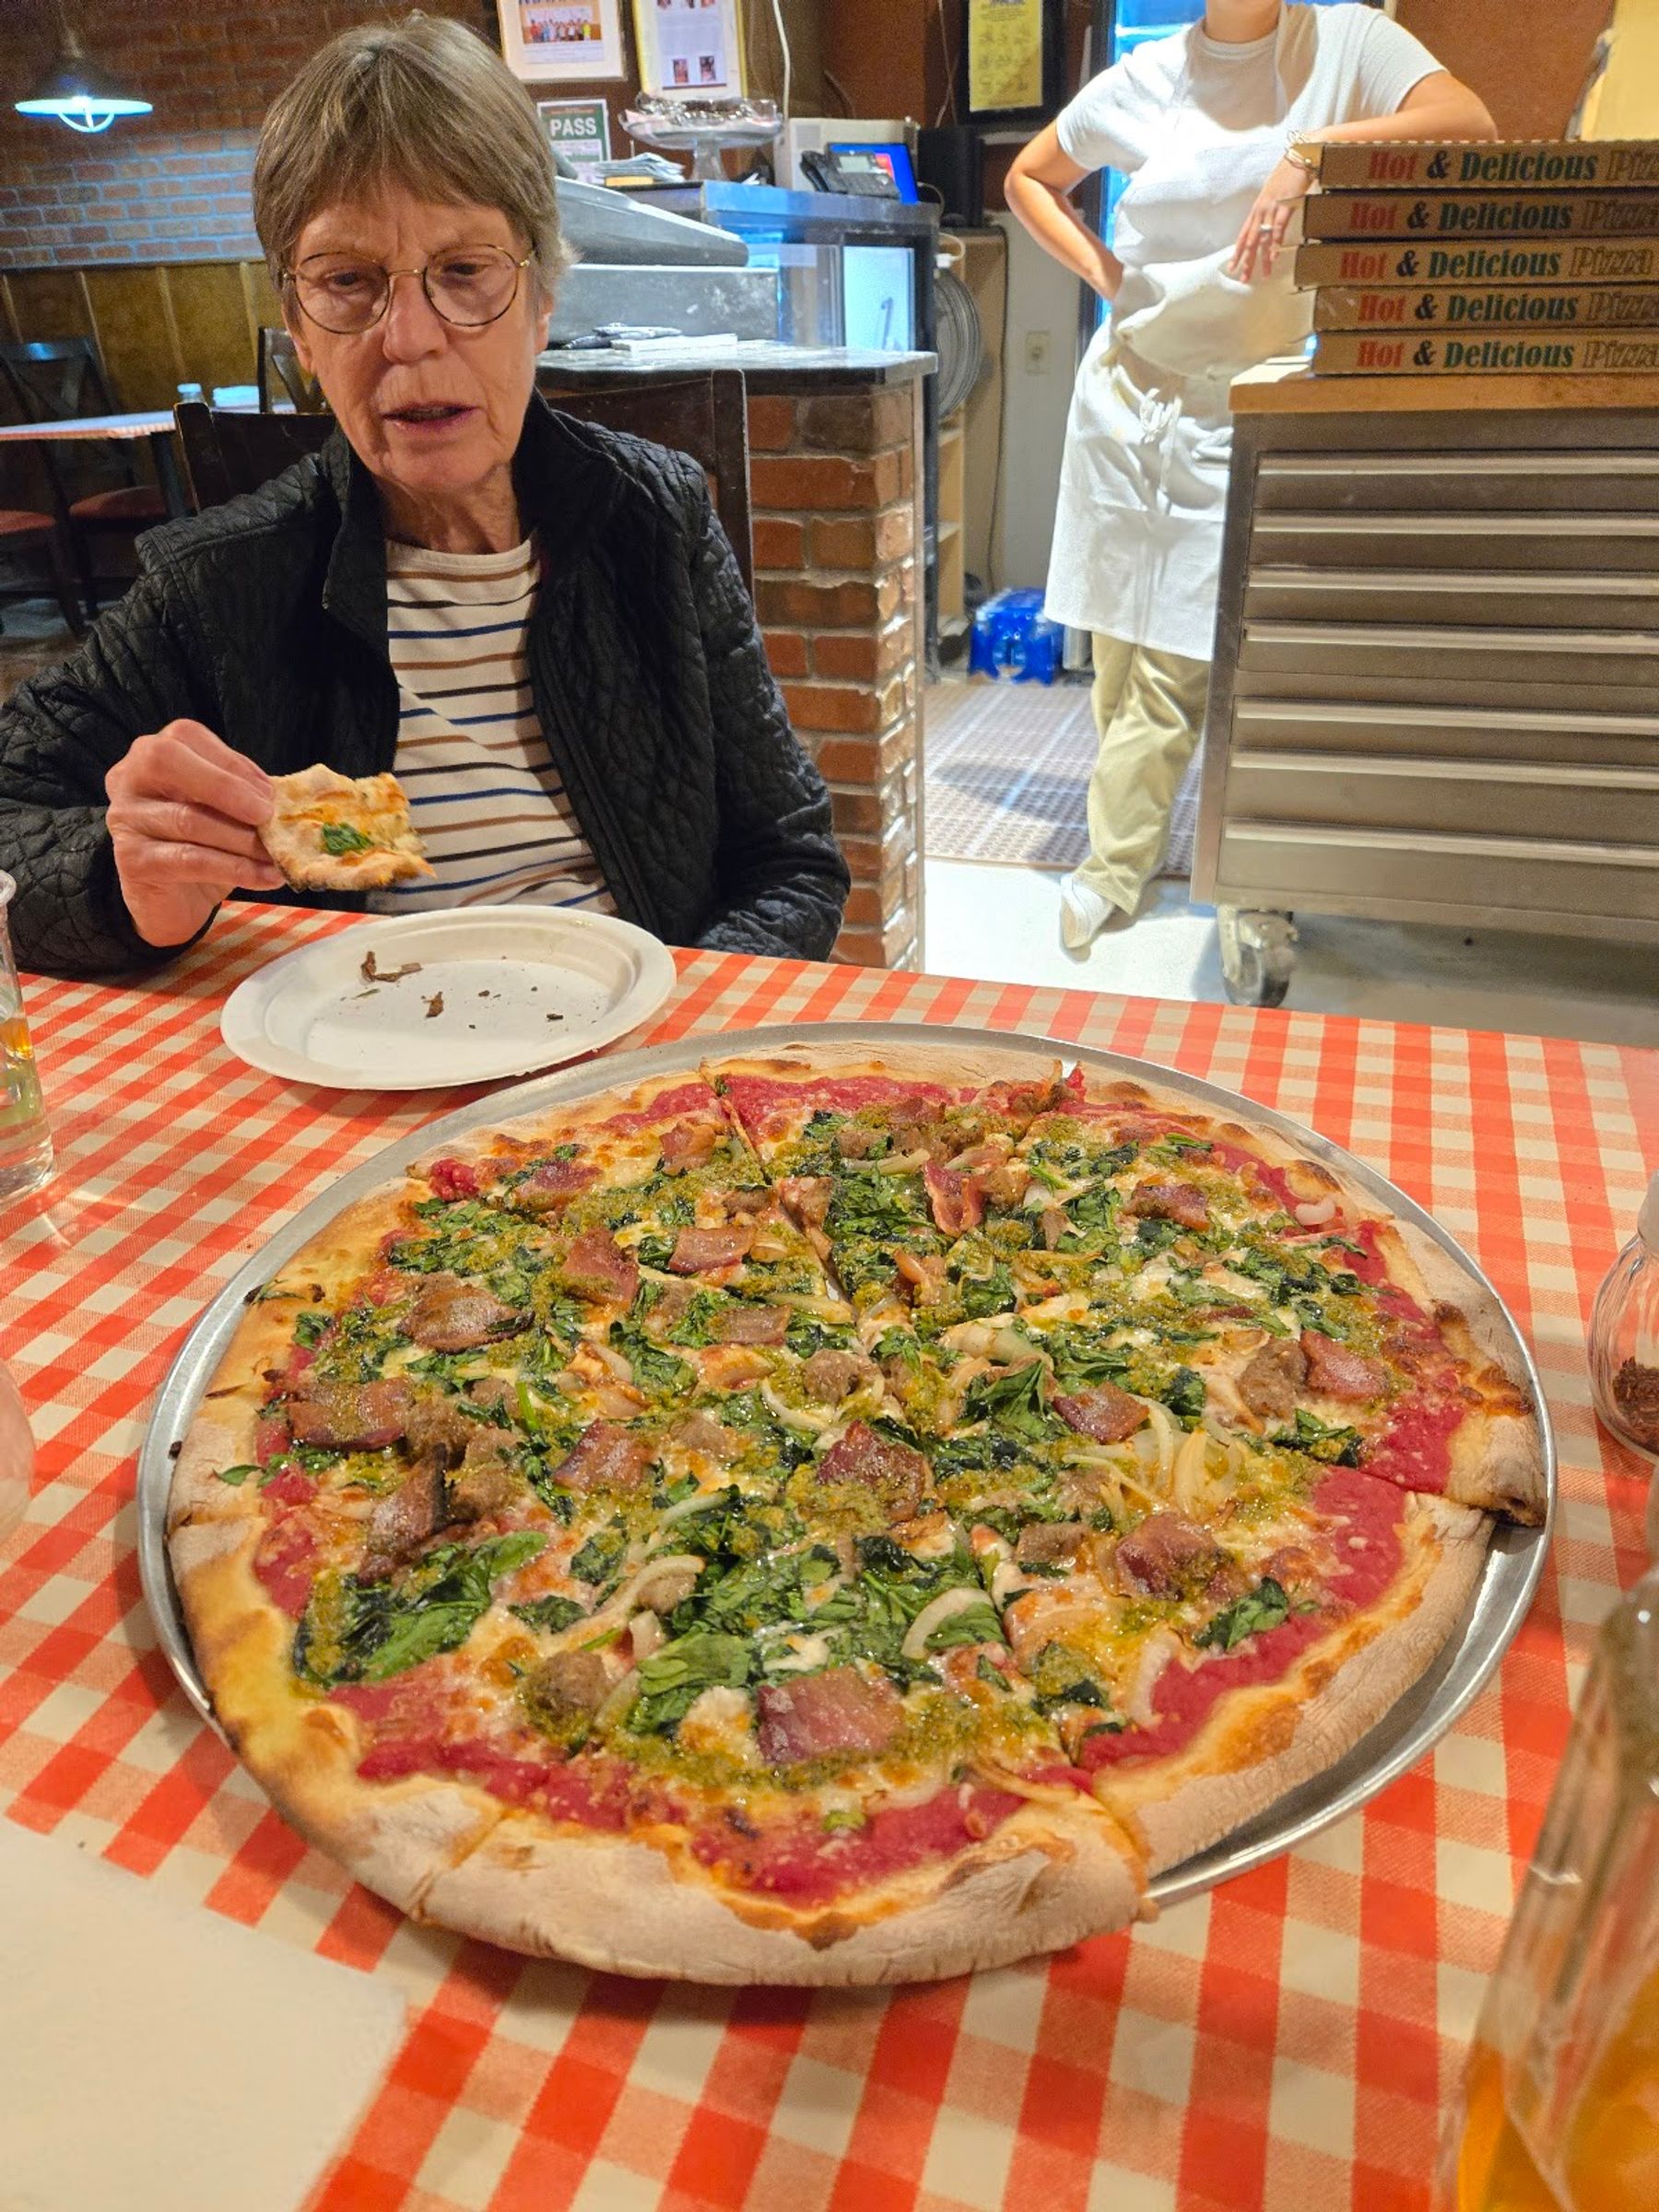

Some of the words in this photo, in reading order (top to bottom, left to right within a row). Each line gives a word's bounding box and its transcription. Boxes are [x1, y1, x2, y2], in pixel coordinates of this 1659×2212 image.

[550, 117, 597, 137] PASS
[1368, 150, 1418, 181] Hot
[1426, 150, 1451, 179] &
[1459, 149, 1599, 182] Delicious
[1349, 202, 1398, 229] Hot
[1406, 201, 1429, 229] &
[1437, 201, 1573, 231] Delicious
[1337, 251, 1388, 278] Hot
[1395, 250, 1420, 277] &
[1429, 250, 1562, 278] Delicious
[1569, 247, 1653, 276] Pizza
[1358, 294, 1406, 322] Hot
[1414, 293, 1439, 321] &
[1446, 293, 1579, 323] Delicious
[1356, 340, 1405, 368] Hot
[1412, 339, 1436, 366] &
[1442, 339, 1575, 369] Delicious
